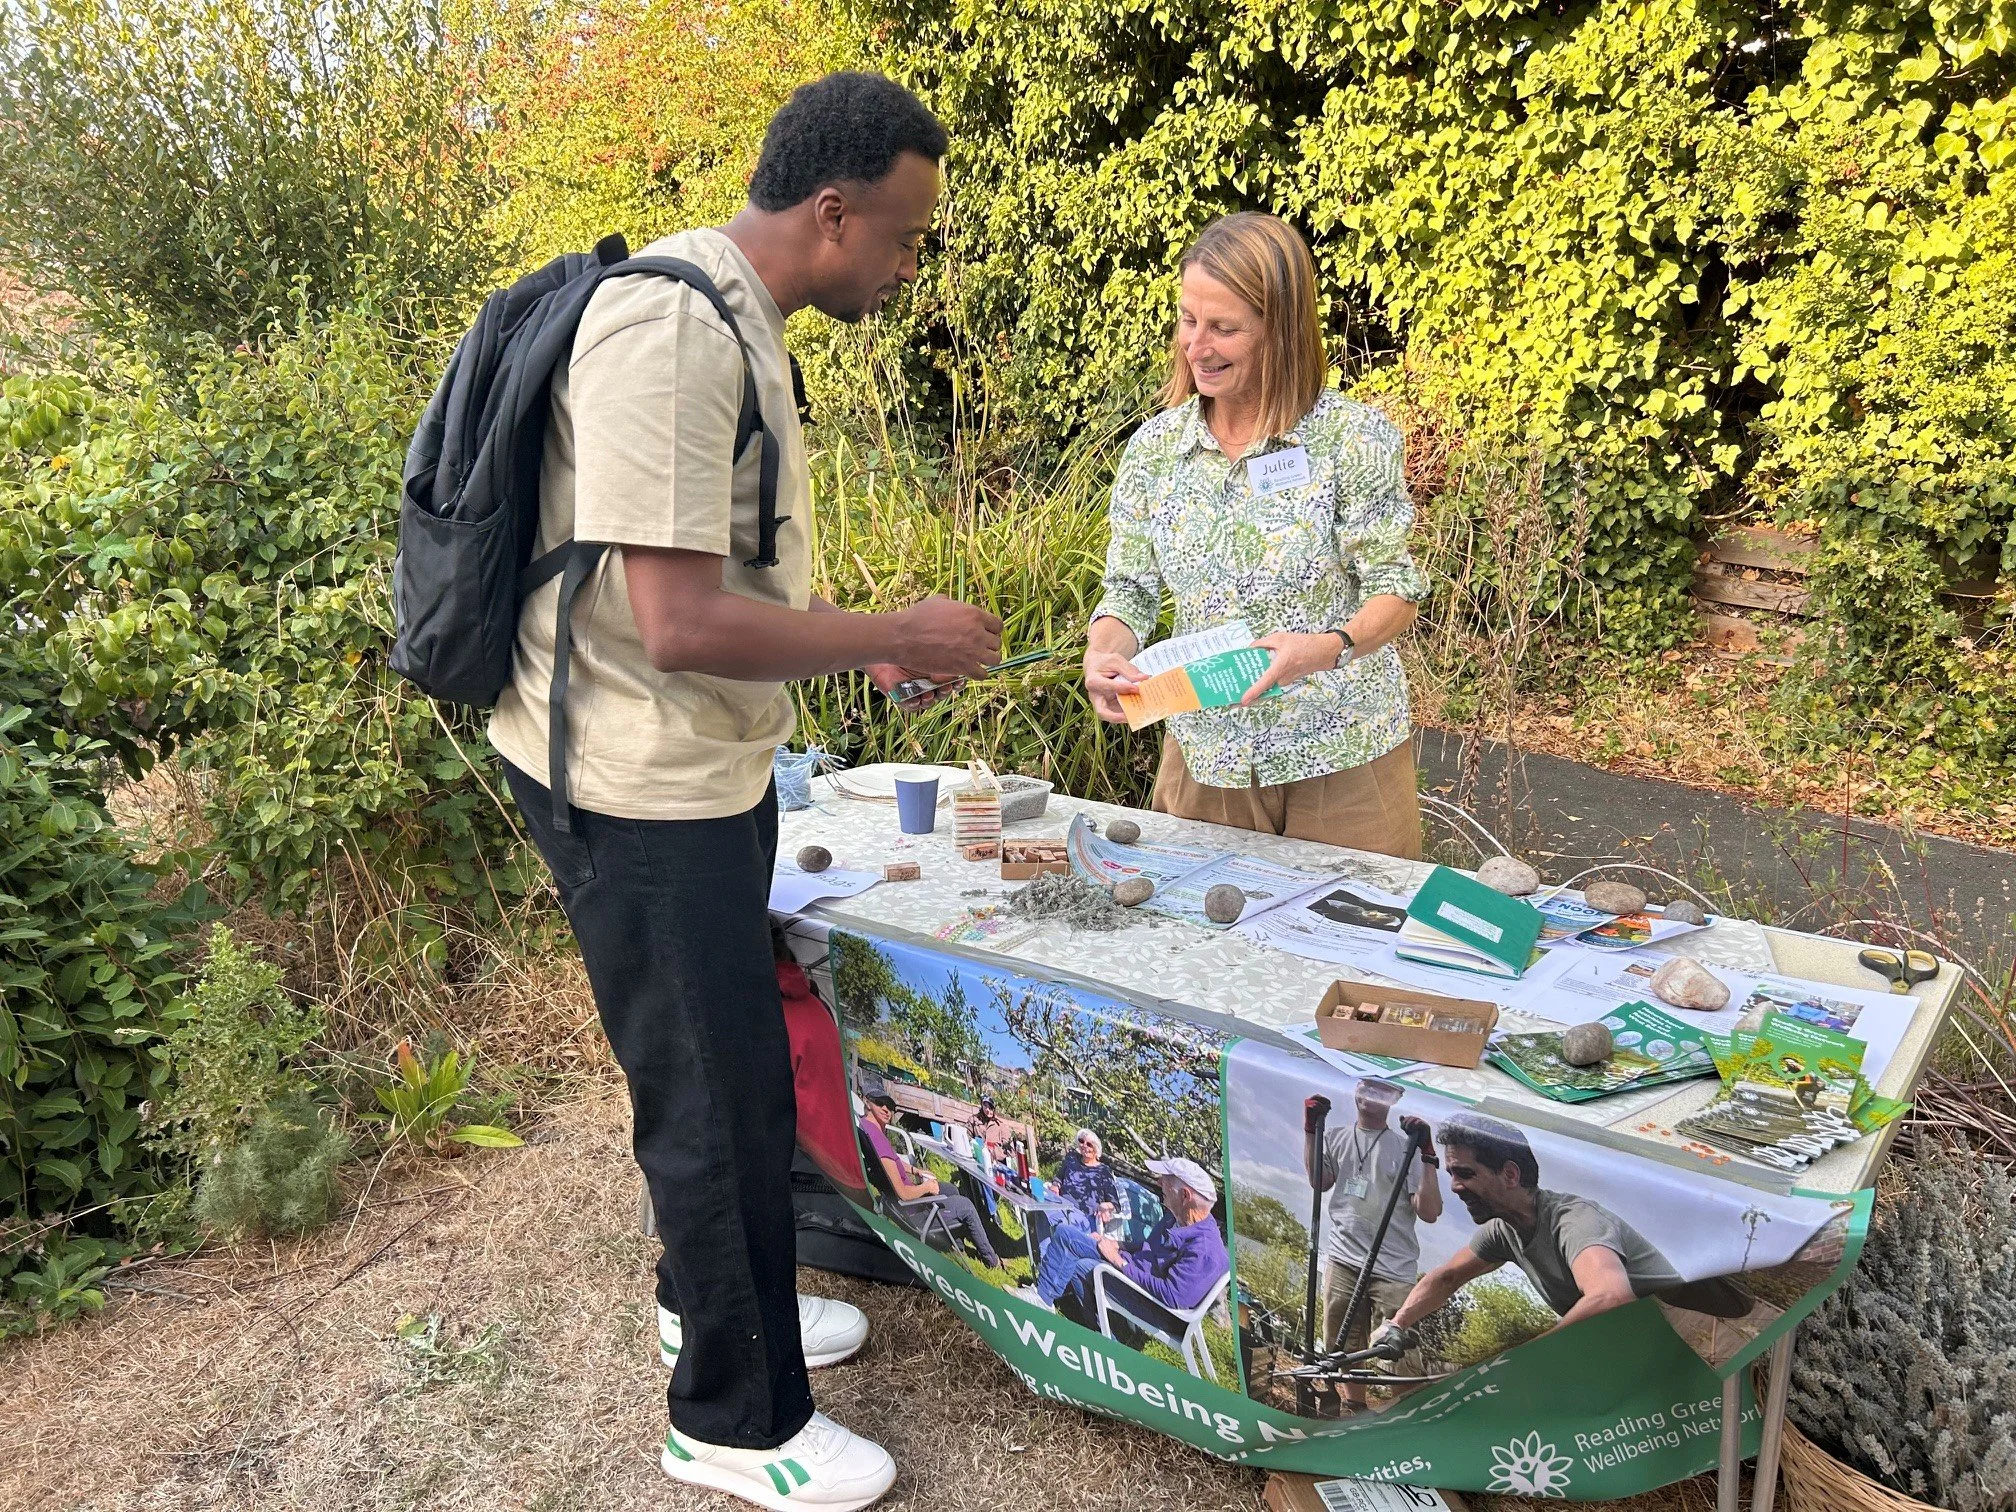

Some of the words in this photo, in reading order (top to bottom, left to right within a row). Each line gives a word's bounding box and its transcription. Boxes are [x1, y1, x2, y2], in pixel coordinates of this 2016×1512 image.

[1262, 458, 1296, 476] Julie
[893, 1239, 998, 1329] Green
[1004, 1308, 1245, 1444] Wellbeing
[1574, 1412, 1666, 1452] Reading
[1671, 1397, 1722, 1419] Gree
[1583, 1430, 1680, 1473] Wellbeing
